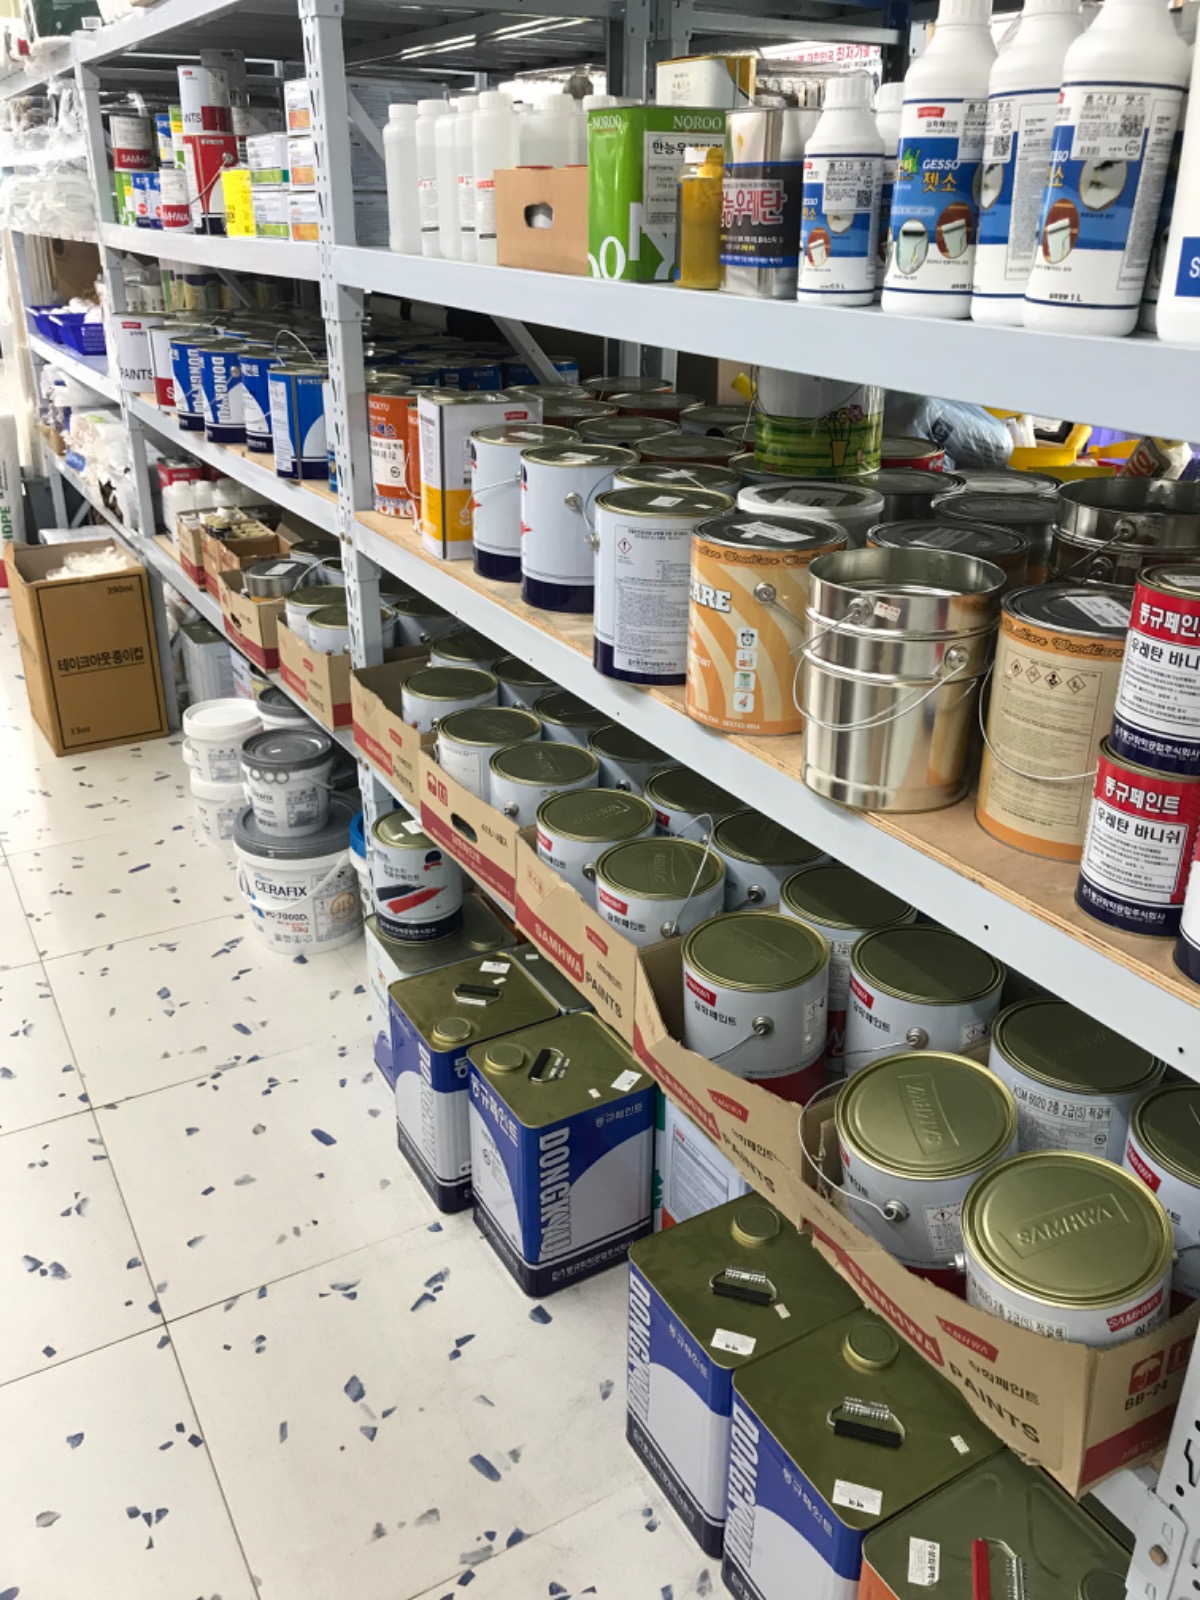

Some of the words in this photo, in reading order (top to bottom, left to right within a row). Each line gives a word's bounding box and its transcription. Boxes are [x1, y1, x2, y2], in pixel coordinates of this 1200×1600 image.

[593, 115, 622, 129] NOROO
[672, 115, 723, 130] NOROO
[922, 158, 961, 171] GESSO
[923, 172, 957, 193] 젯소
[120, 367, 154, 381] PAINTS
[107, 583, 134, 595] 390ml
[689, 581, 732, 613] ARE
[1140, 602, 1200, 638] 동규페인
[1131, 636, 1164, 664] 우레탄
[1168, 649, 1200, 672] 바니
[1105, 775, 1180, 815] 동규페인트
[1096, 806, 1129, 834] 우레탄
[1134, 822, 1181, 845] 바니쉬
[254, 881, 308, 898] CERAFIX
[534, 922, 583, 977] SAMHWA
[585, 970, 623, 1019] PAINTS
[693, 999, 738, 1027] 삼화페인트
[1028, 1093, 1047, 1111] 6020
[538, 1126, 572, 1256] DONGKYU
[1015, 1203, 1114, 1248] SAMHWA
[848, 1260, 940, 1361] SAMHWA
[1104, 1295, 1160, 1327] SAMHWA
[627, 1270, 652, 1423] DONGKYU
[939, 1321, 990, 1354] SAMHWA
[948, 1360, 1041, 1445] PAINTS
[723, 1400, 760, 1570] DONGKYU
